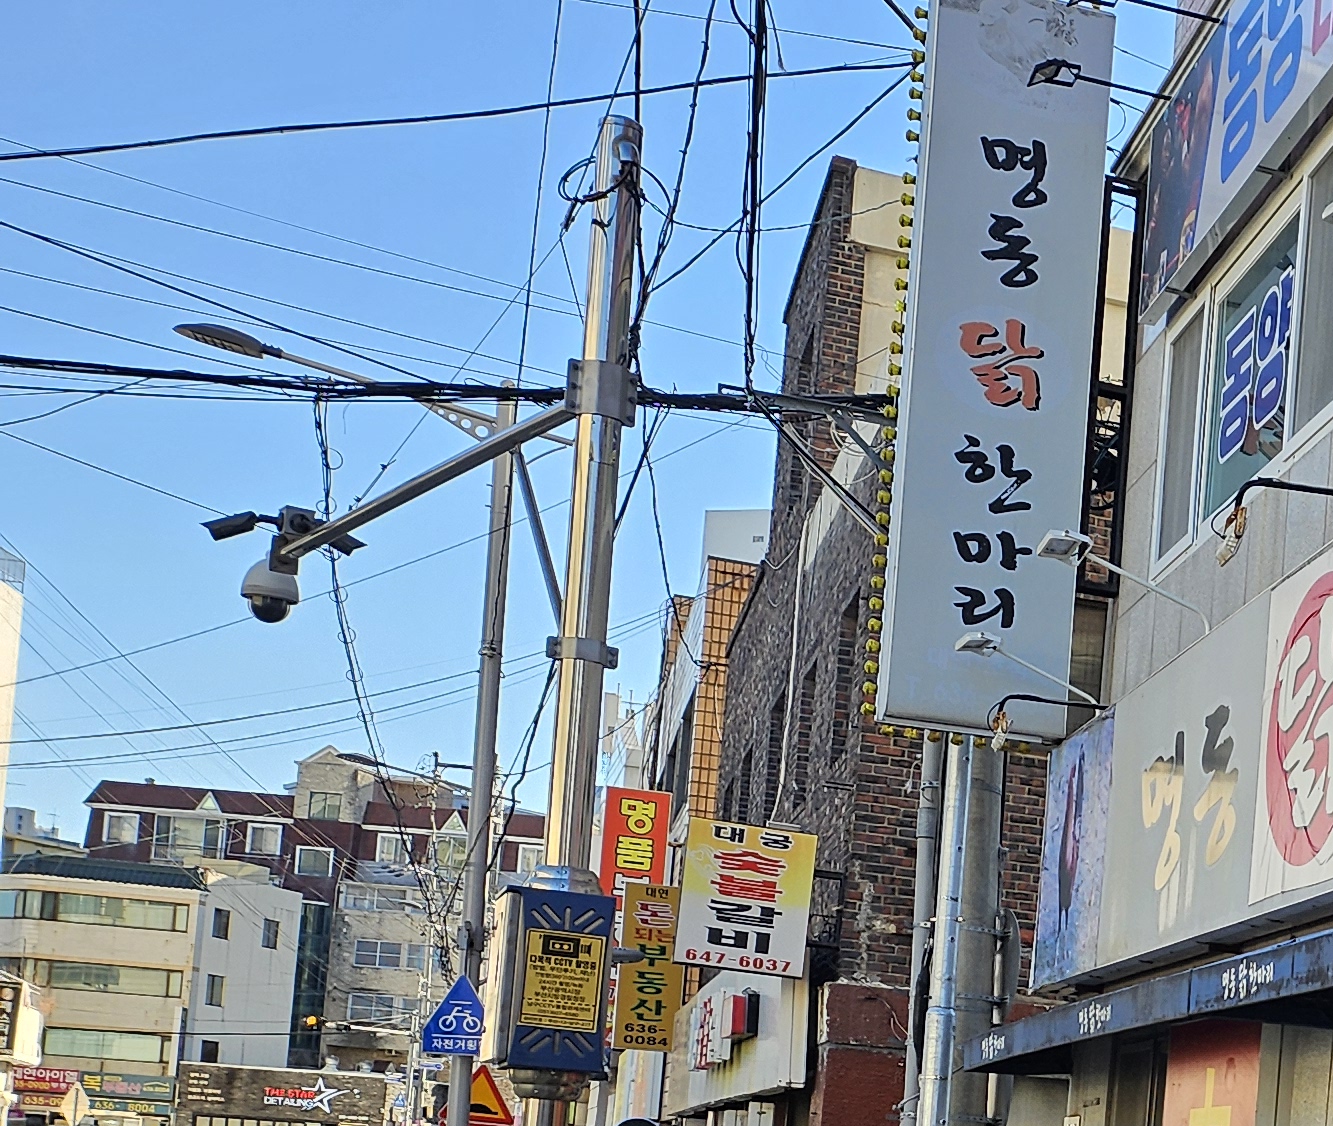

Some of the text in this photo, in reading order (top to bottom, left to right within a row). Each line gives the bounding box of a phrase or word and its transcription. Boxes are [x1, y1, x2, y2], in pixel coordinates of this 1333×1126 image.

[954, 135, 1047, 629] 명동 닭 한마리
[1142, 706, 1239, 889] 명동
[645, 887, 669, 899] 대연
[633, 901, 674, 928] 돈
[634, 928, 674, 943] 되는
[685, 949, 792, 973] 647-6037
[630, 944, 670, 1022] 부동산
[624, 1023, 666, 1034] 636-
[432, 1038, 480, 1050] 자전거횡
[623, 1035, 668, 1047] 0084
[24, 1095, 65, 1107] 635-09
